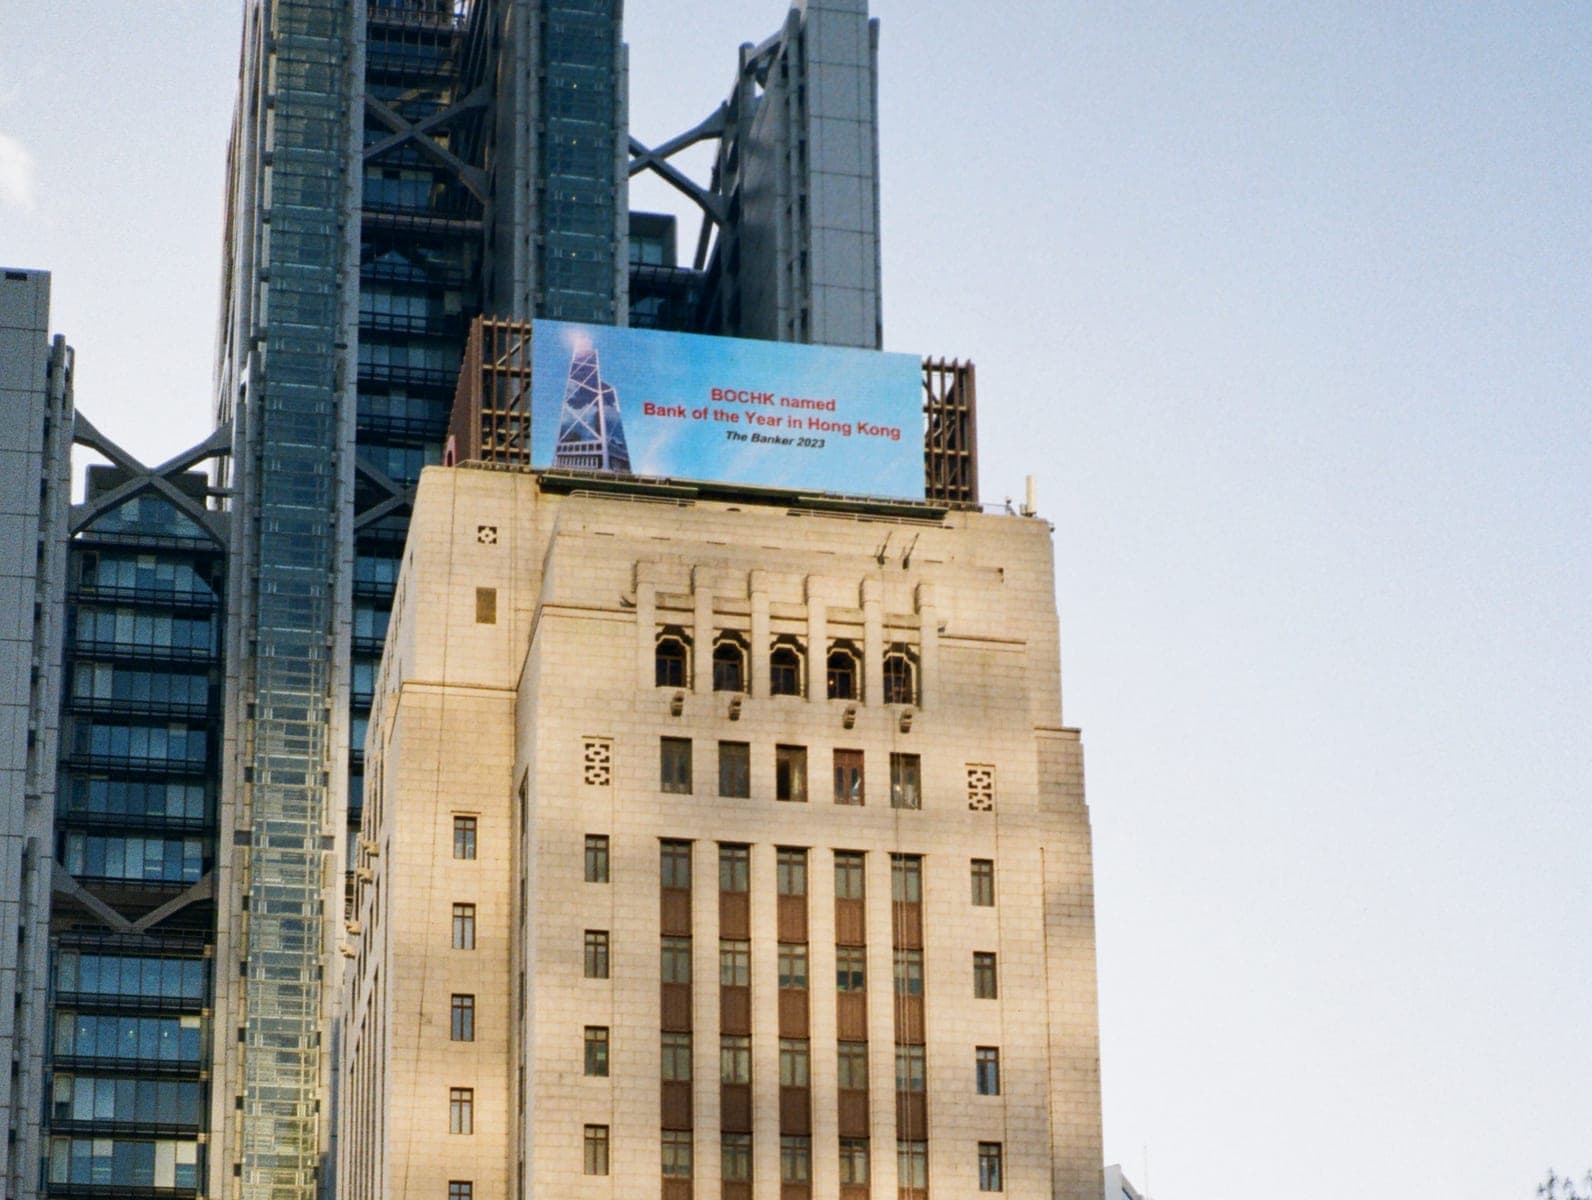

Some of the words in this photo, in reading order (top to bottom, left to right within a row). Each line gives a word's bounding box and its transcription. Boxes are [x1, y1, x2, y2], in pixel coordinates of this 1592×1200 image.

[711, 387, 774, 406] BOCHK
[780, 396, 836, 412] named
[643, 402, 686, 418] Bank
[692, 406, 708, 420] of
[714, 409, 739, 423] the
[745, 411, 782, 427] Year
[788, 415, 802, 429] in
[808, 417, 851, 436] Hong
[858, 421, 900, 441] Kong
[726, 430, 748, 442] The
[751, 433, 793, 446] Banker
[797, 437, 825, 449] 2023
